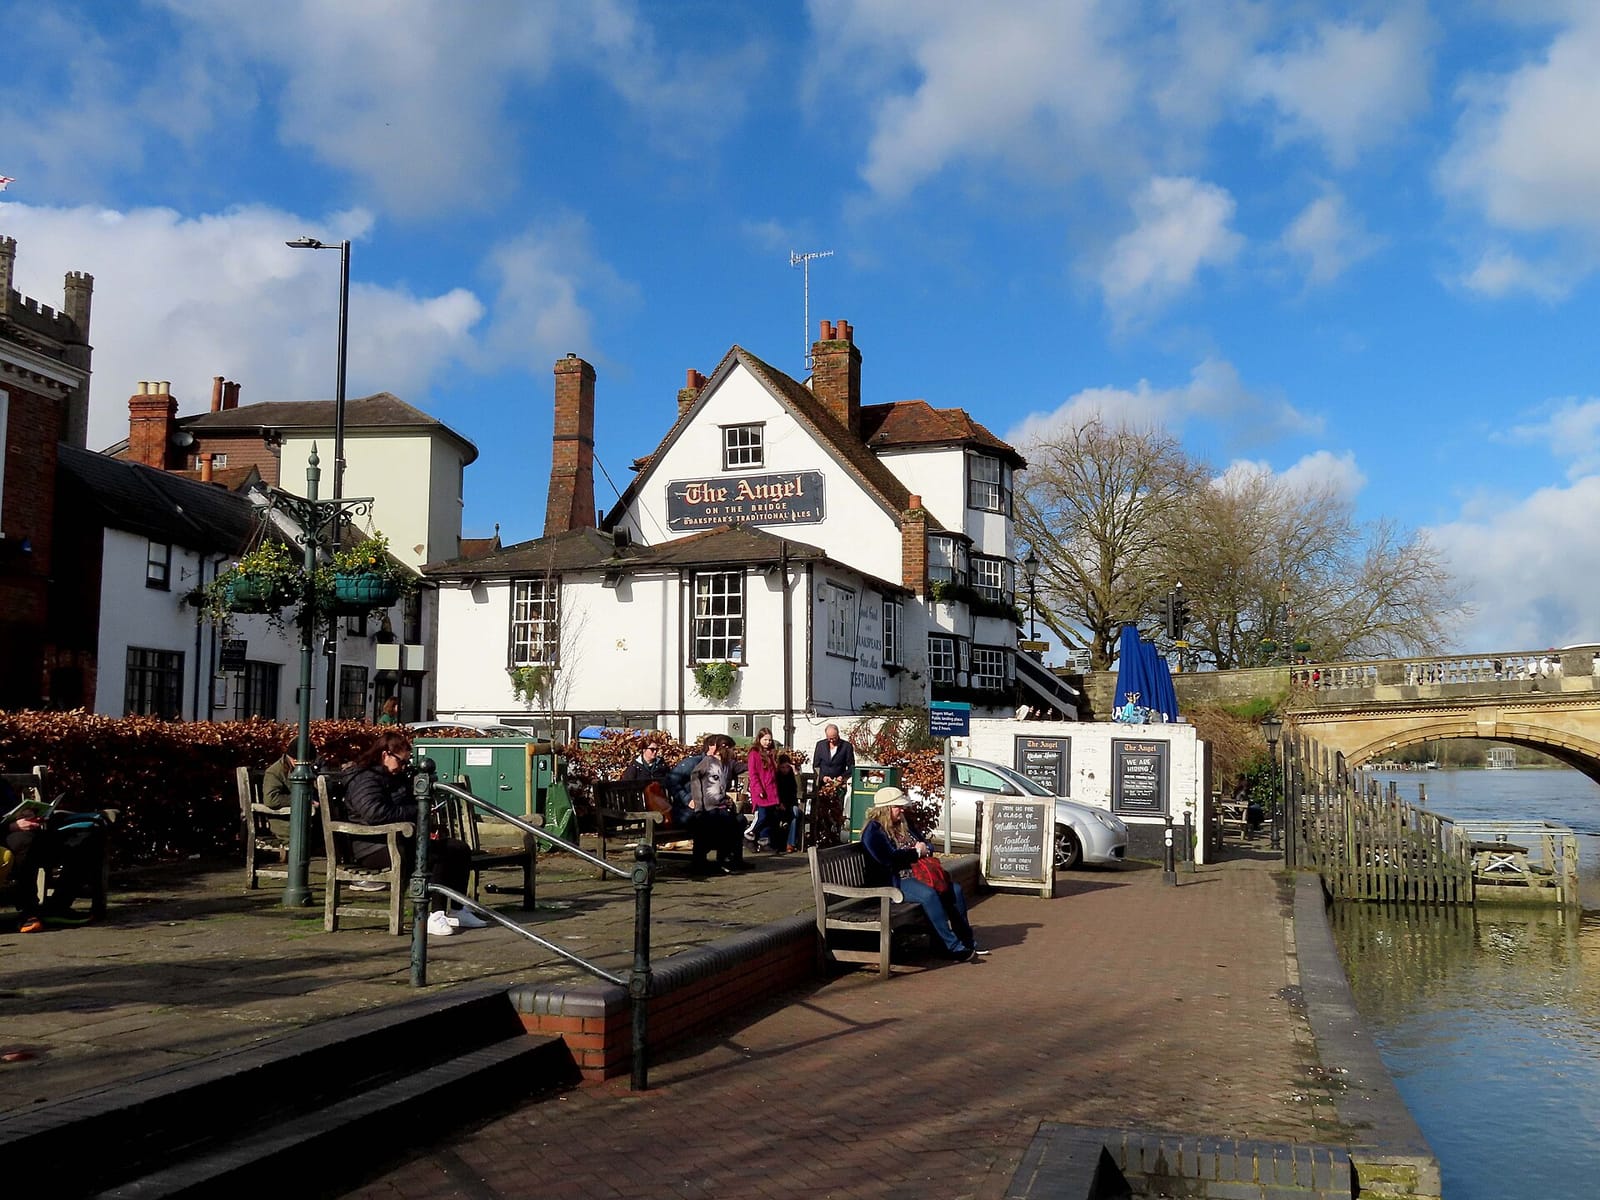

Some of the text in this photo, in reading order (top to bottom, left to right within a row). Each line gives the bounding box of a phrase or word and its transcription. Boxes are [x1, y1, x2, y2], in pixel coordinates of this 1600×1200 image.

[685, 475, 804, 504] The Angel
[705, 503, 787, 515] ON THE BRIDGE
[736, 511, 788, 522] TRADITIONAL
[851, 671, 886, 691] RESTAURANT
[1027, 740, 1058, 749] The Angel
[1124, 743, 1157, 752] The Angel
[995, 820, 1038, 832] Mulled Wine
[1003, 835, 1030, 845] Toasted
[1000, 863, 1031, 872] LOG FIRE
